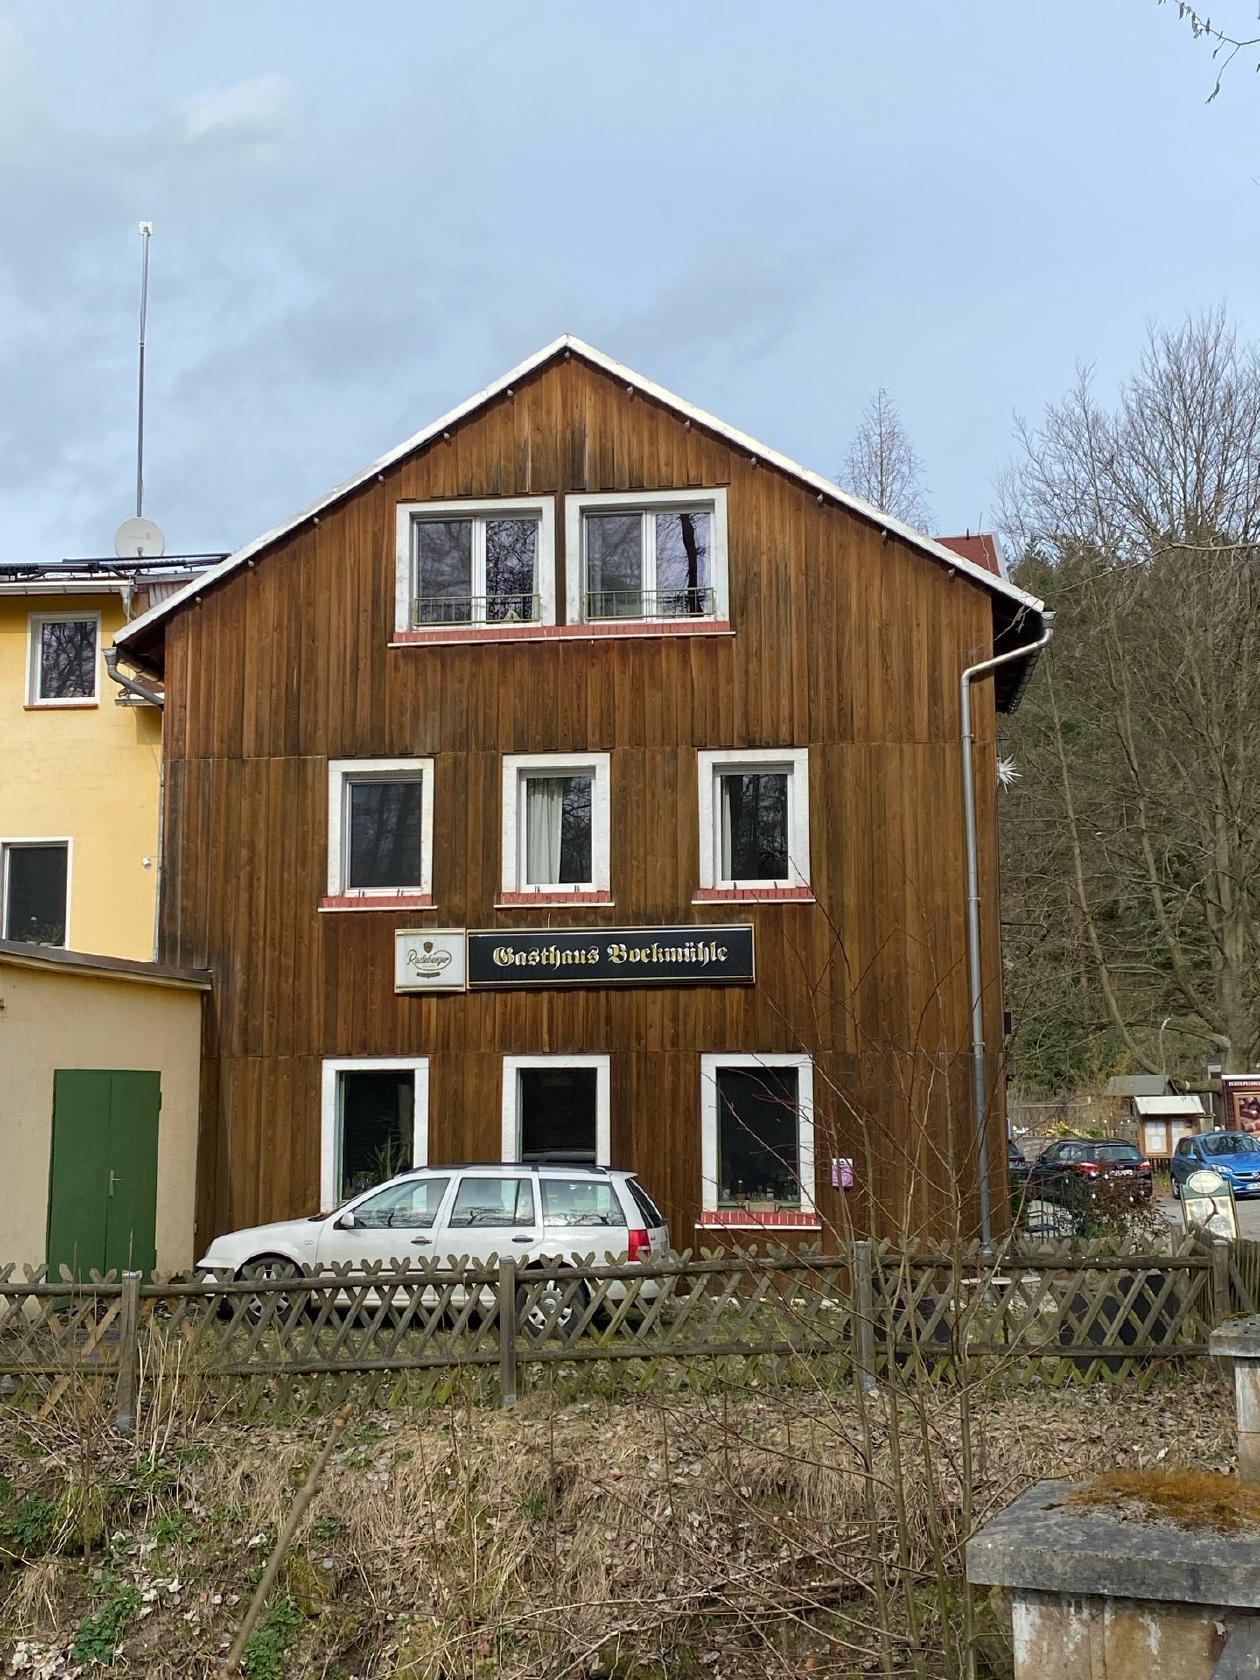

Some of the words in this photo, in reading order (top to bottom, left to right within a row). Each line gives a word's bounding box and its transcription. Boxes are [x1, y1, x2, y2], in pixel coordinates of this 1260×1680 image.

[406, 949, 451, 969] Radeberger
[492, 944, 600, 970] Gasthaus
[607, 941, 729, 967] Bockmühle
